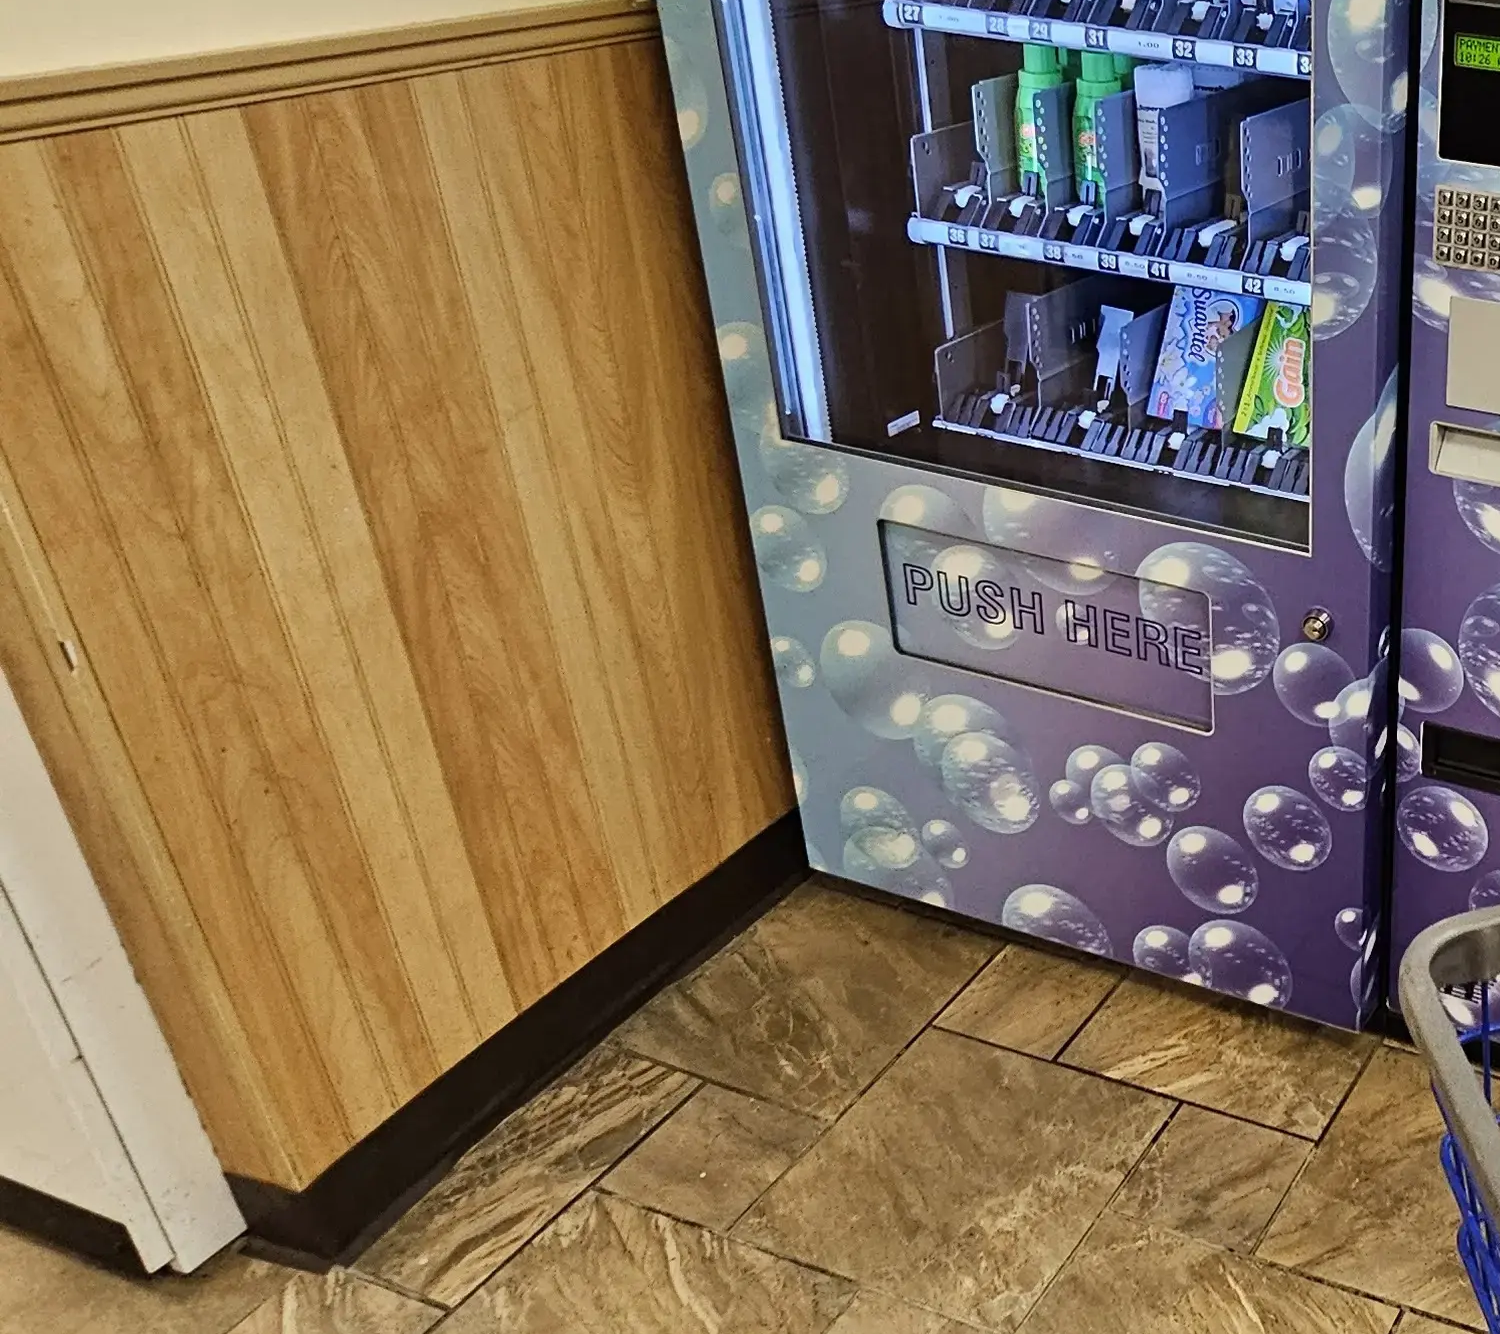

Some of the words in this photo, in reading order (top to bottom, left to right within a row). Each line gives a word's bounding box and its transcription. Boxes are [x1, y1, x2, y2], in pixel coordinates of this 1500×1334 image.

[903, 6, 920, 21] 27
[989, 18, 1005, 33] 28
[1033, 23, 1049, 38] 29
[1088, 31, 1105, 46] 31
[1174, 39, 1193, 58] 32
[1236, 49, 1254, 66] 33
[1459, 52, 1492, 66] 10:26
[981, 234, 996, 248] 37
[1046, 244, 1061, 260] 38
[1101, 255, 1117, 270] 39
[1151, 263, 1167, 278] 41
[1244, 279, 1262, 293] 42
[1189, 287, 1212, 363] Suavitel
[1274, 338, 1306, 407] Gain
[902, 563, 1045, 636] PUSH
[1064, 598, 1204, 677] HERE
